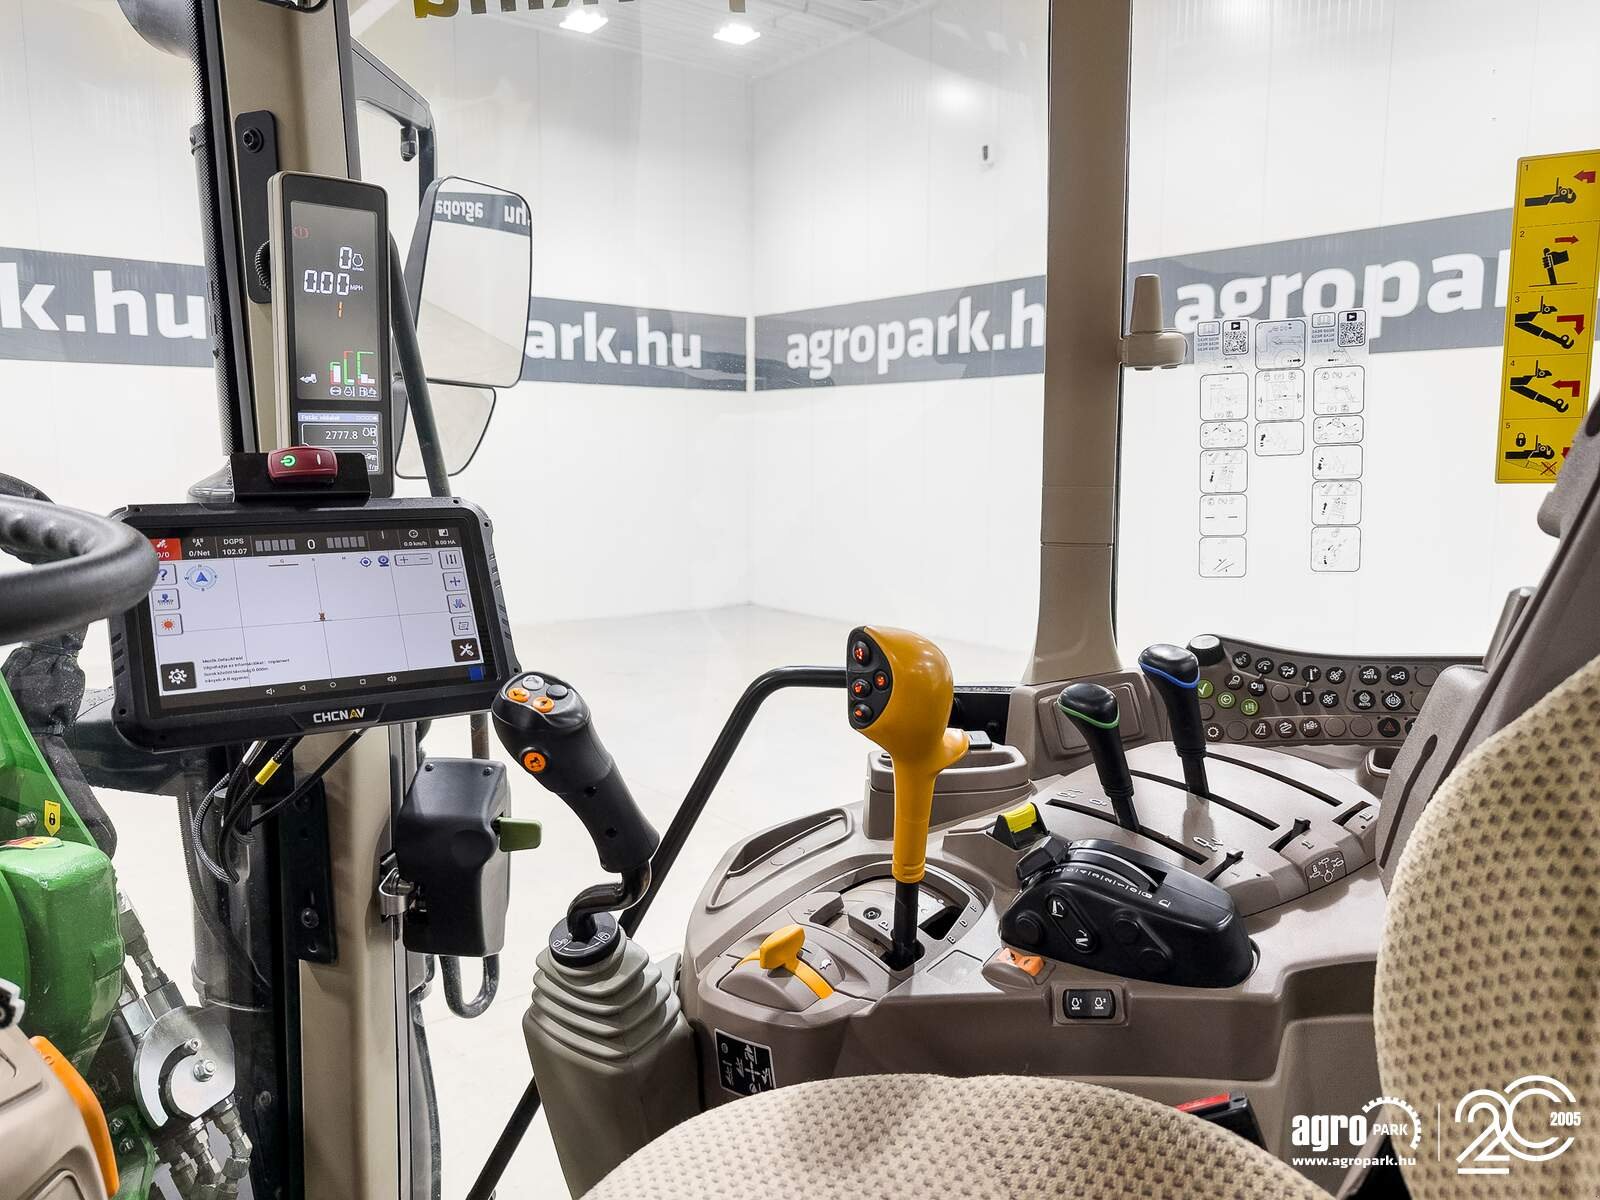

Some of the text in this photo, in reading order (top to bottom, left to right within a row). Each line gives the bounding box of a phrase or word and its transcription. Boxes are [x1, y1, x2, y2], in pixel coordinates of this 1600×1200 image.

[1519, 230, 1525, 238] 2
[339, 246, 352, 269] 0
[303, 269, 350, 295] 0.00
[1514, 295, 1521, 303] 3
[786, 288, 1044, 380] agropark.h
[325, 430, 359, 440] 2777.8
[223, 537, 244, 545] DGPS
[307, 539, 316, 550] 0
[188, 549, 211, 557] 0/Net
[222, 547, 249, 556] 102.07
[312, 707, 366, 724] CHCNAV
